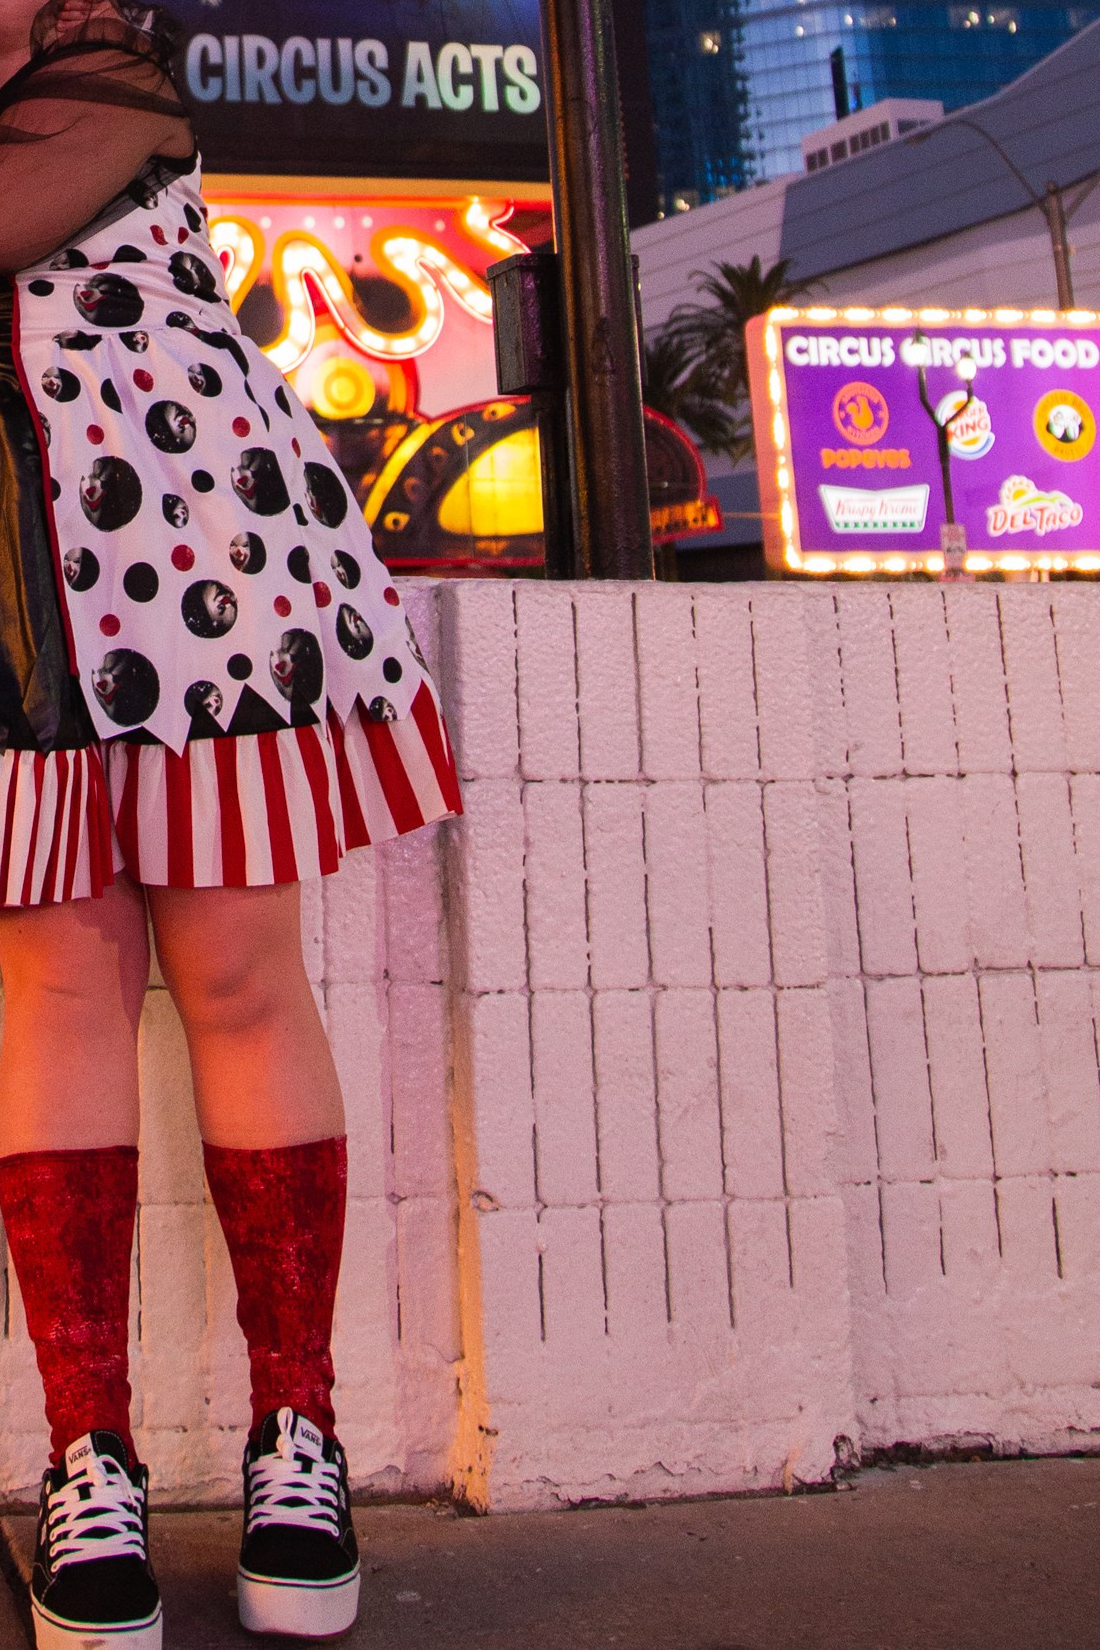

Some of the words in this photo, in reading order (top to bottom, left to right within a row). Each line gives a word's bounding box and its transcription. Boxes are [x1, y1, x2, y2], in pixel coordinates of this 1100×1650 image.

[186, 33, 392, 108] CIRCUS
[402, 41, 542, 114] ACTS
[786, 335, 896, 368] CIRCUS
[1010, 337, 1100, 369] FOOD
[947, 417, 989, 440] KING
[300, 1426, 321, 1447] VANS
[68, 1445, 90, 1465] VANS
